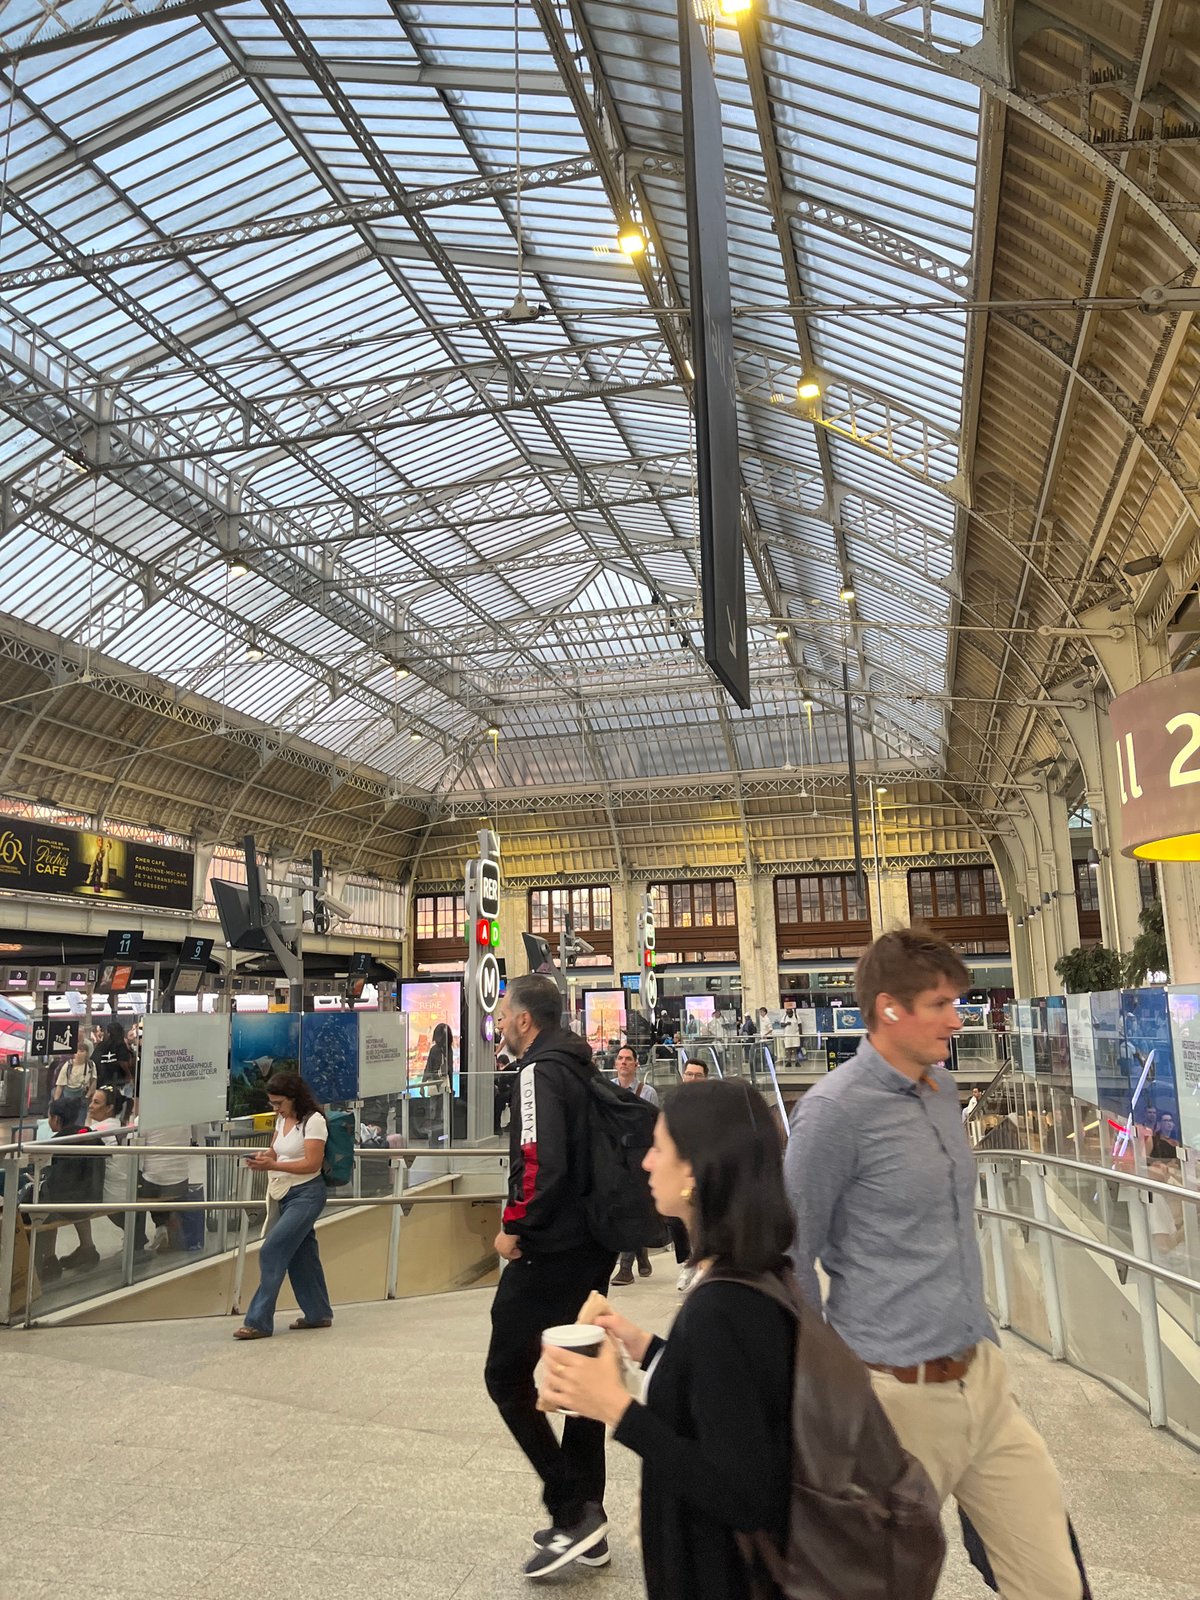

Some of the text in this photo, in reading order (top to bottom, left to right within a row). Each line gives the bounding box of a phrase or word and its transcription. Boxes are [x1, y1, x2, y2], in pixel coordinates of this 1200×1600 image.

[1165, 712, 1200, 788] 2
[134, 865, 176, 876] PARDONNE-MOI
[483, 877, 498, 901] RER
[482, 926, 498, 940] A D
[120, 940, 130, 952] 11
[194, 946, 201, 957] 9
[484, 966, 495, 998] M
[523, 1080, 533, 1133] TOMMY
